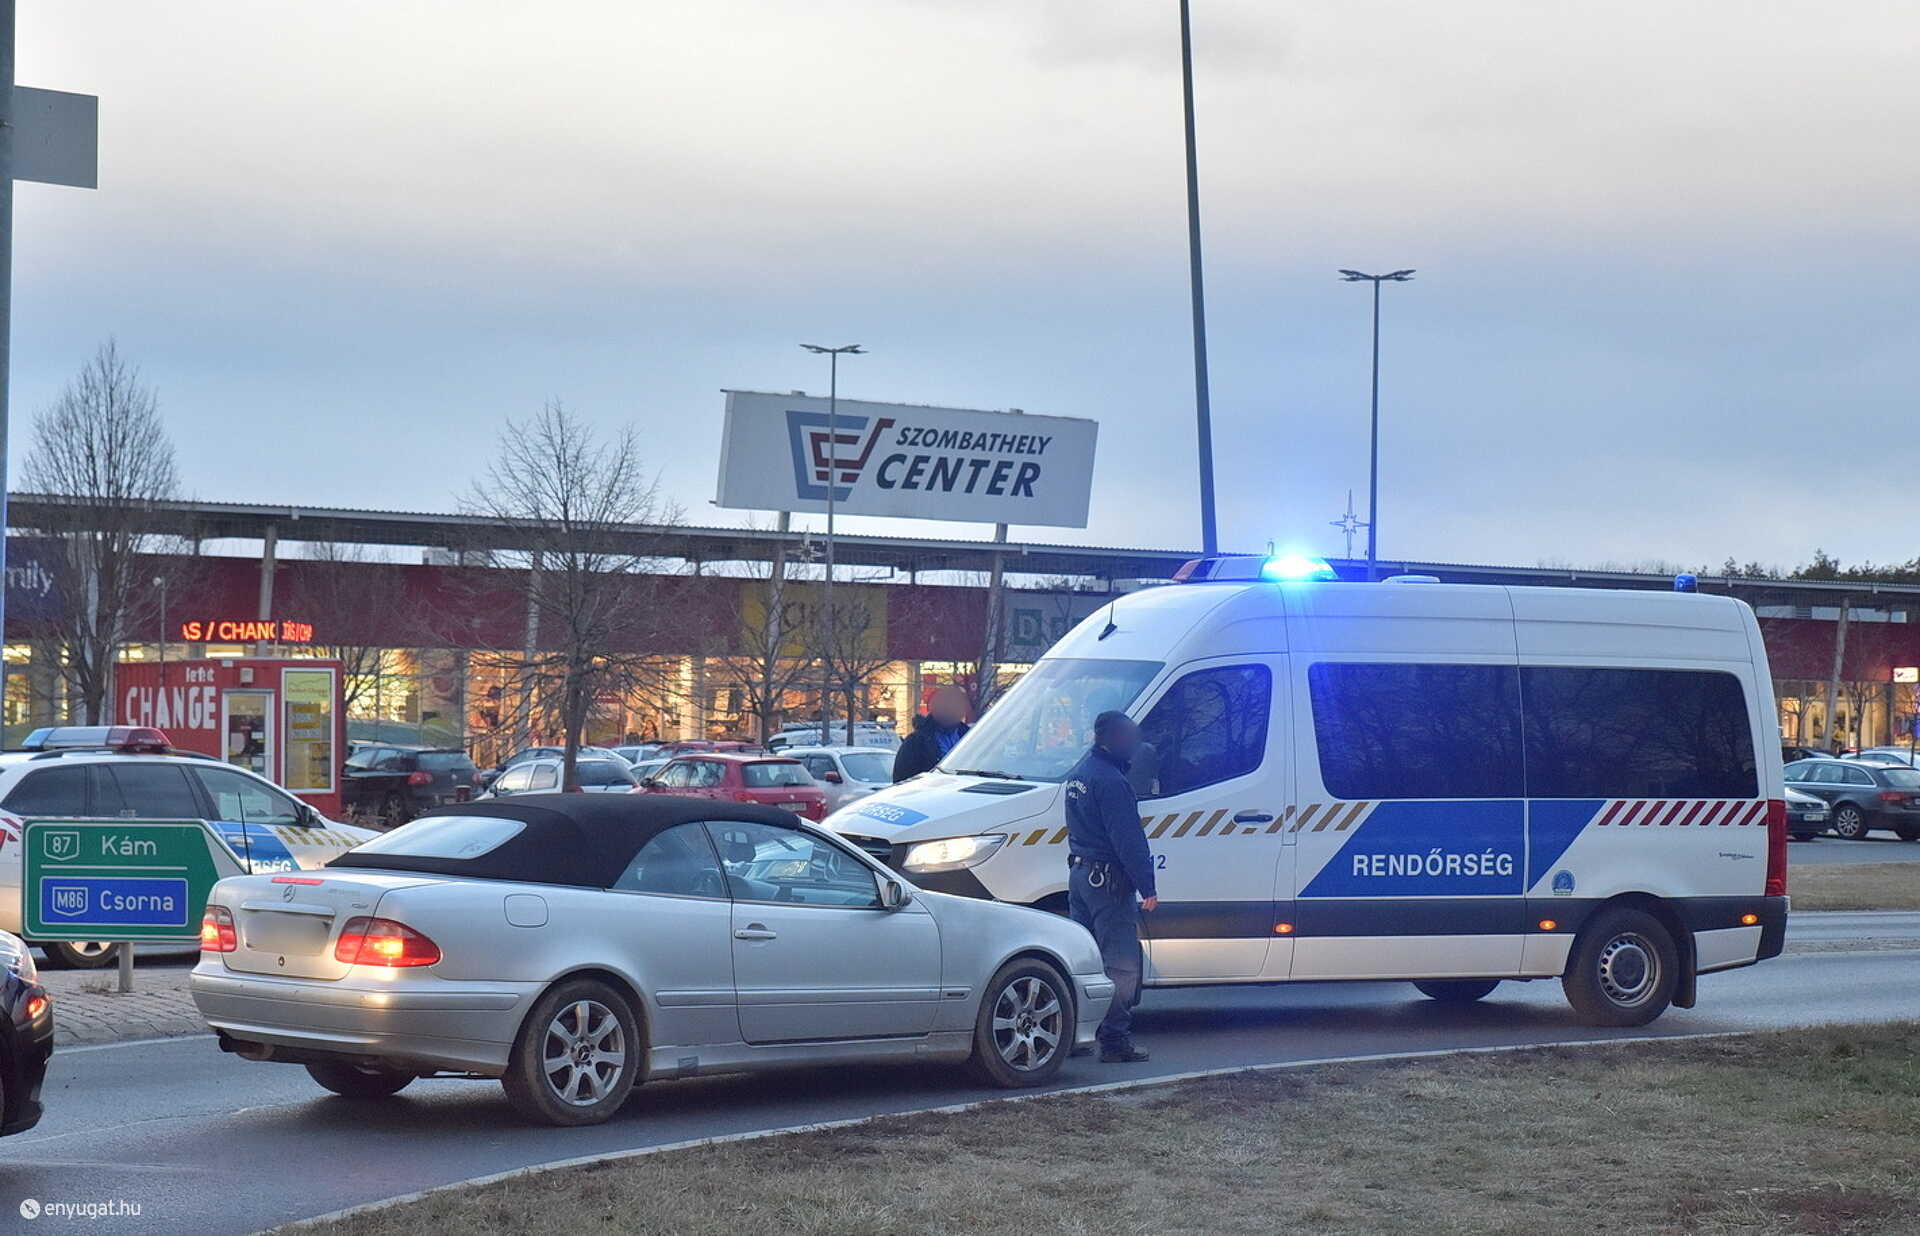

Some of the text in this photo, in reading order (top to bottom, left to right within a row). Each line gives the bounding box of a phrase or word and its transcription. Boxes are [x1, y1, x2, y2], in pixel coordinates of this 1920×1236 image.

[895, 427, 1052, 456] SZOMBATHELY
[875, 453, 1041, 498] CENTER
[125, 685, 216, 729] CHANGE
[52, 835, 157, 856] 87 Kám
[1352, 848, 1513, 876] RENDŐRSÉG
[56, 890, 174, 911] M86 Csorna
